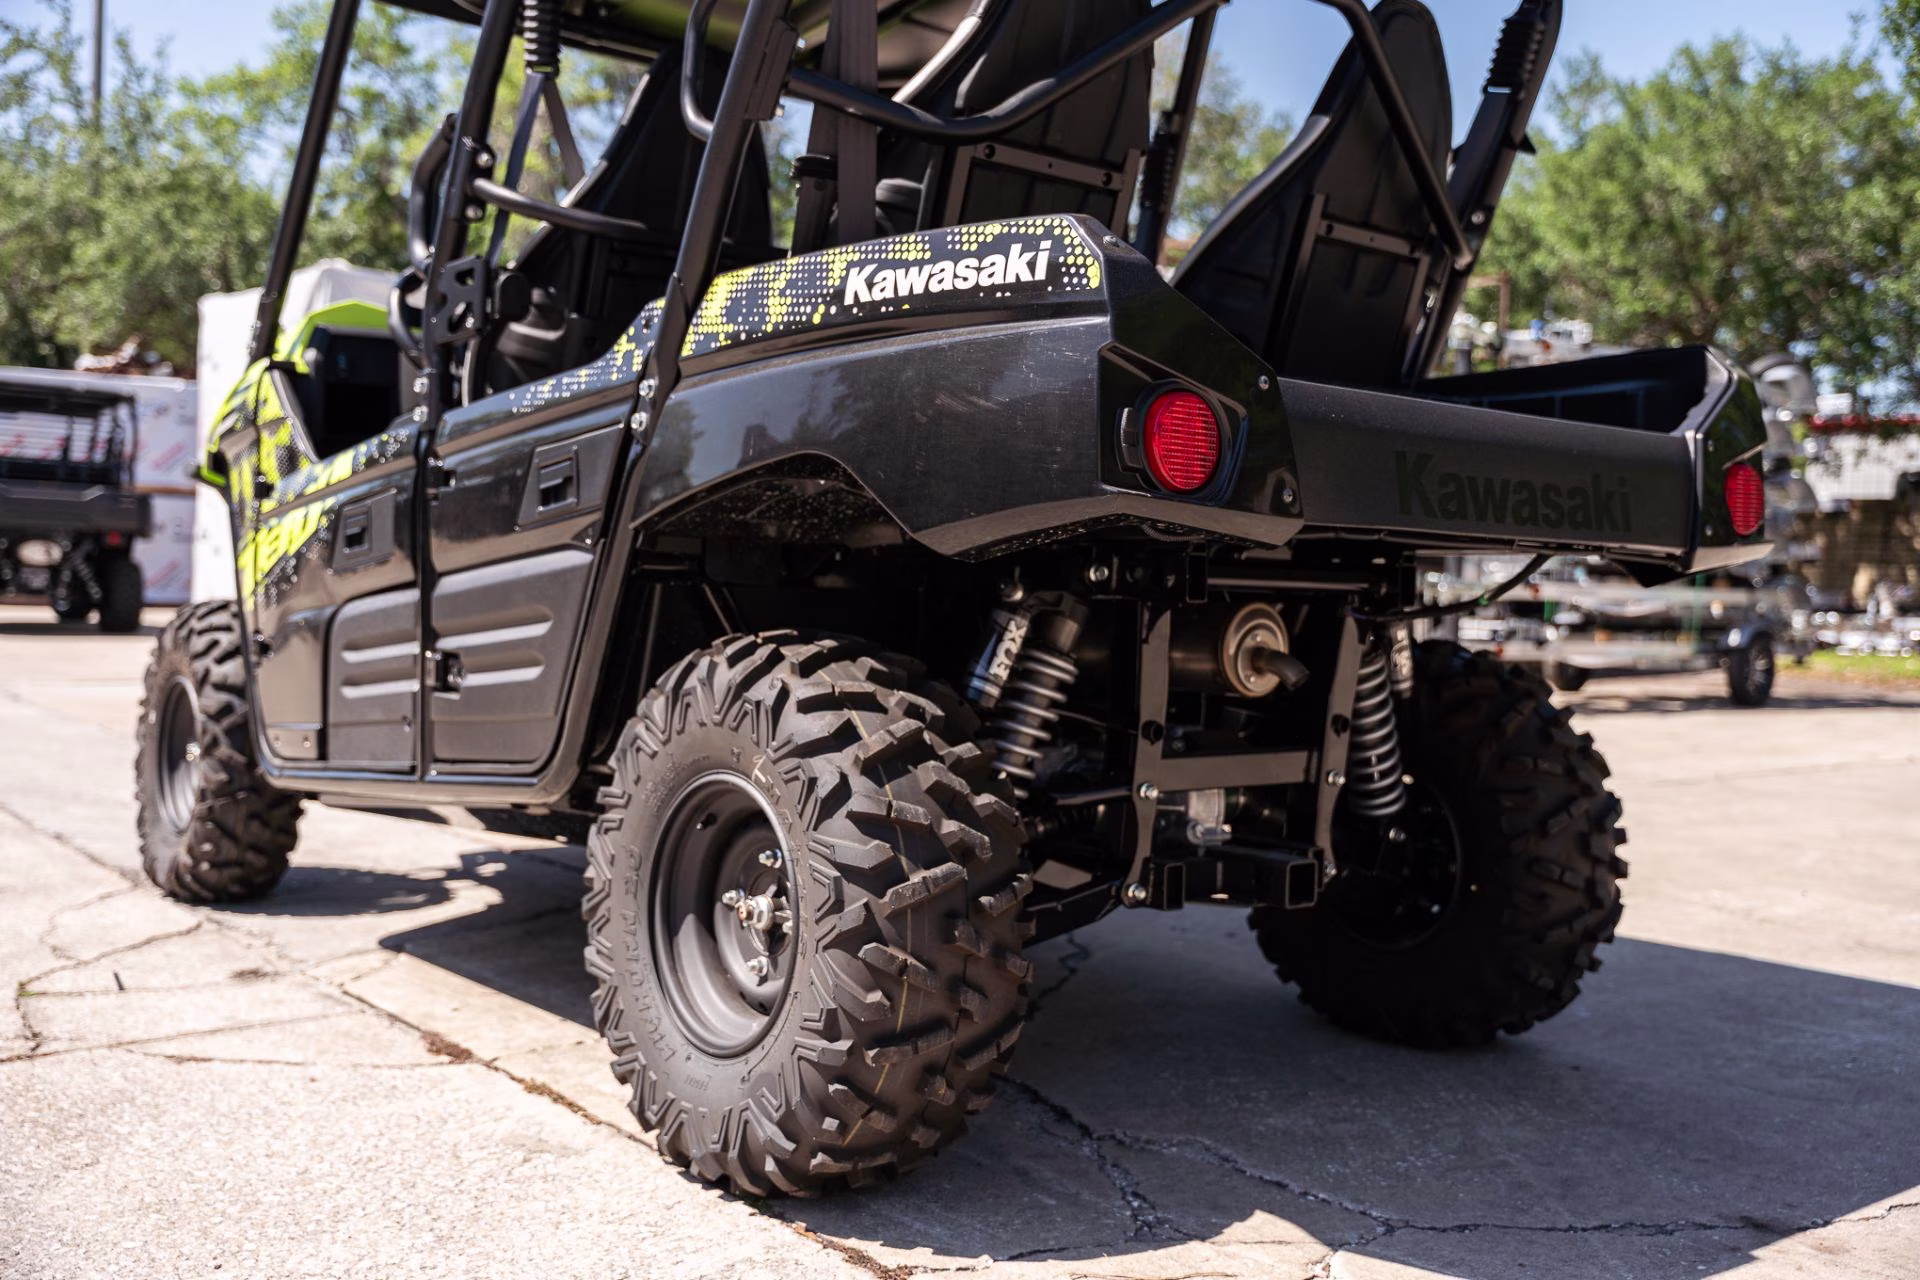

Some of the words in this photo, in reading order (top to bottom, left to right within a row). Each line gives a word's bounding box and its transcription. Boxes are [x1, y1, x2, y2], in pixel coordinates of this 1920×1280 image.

[844, 240, 1052, 305] Kawasaki
[1394, 451, 1632, 532] Kawasaki
[988, 620, 1027, 681] FOX
